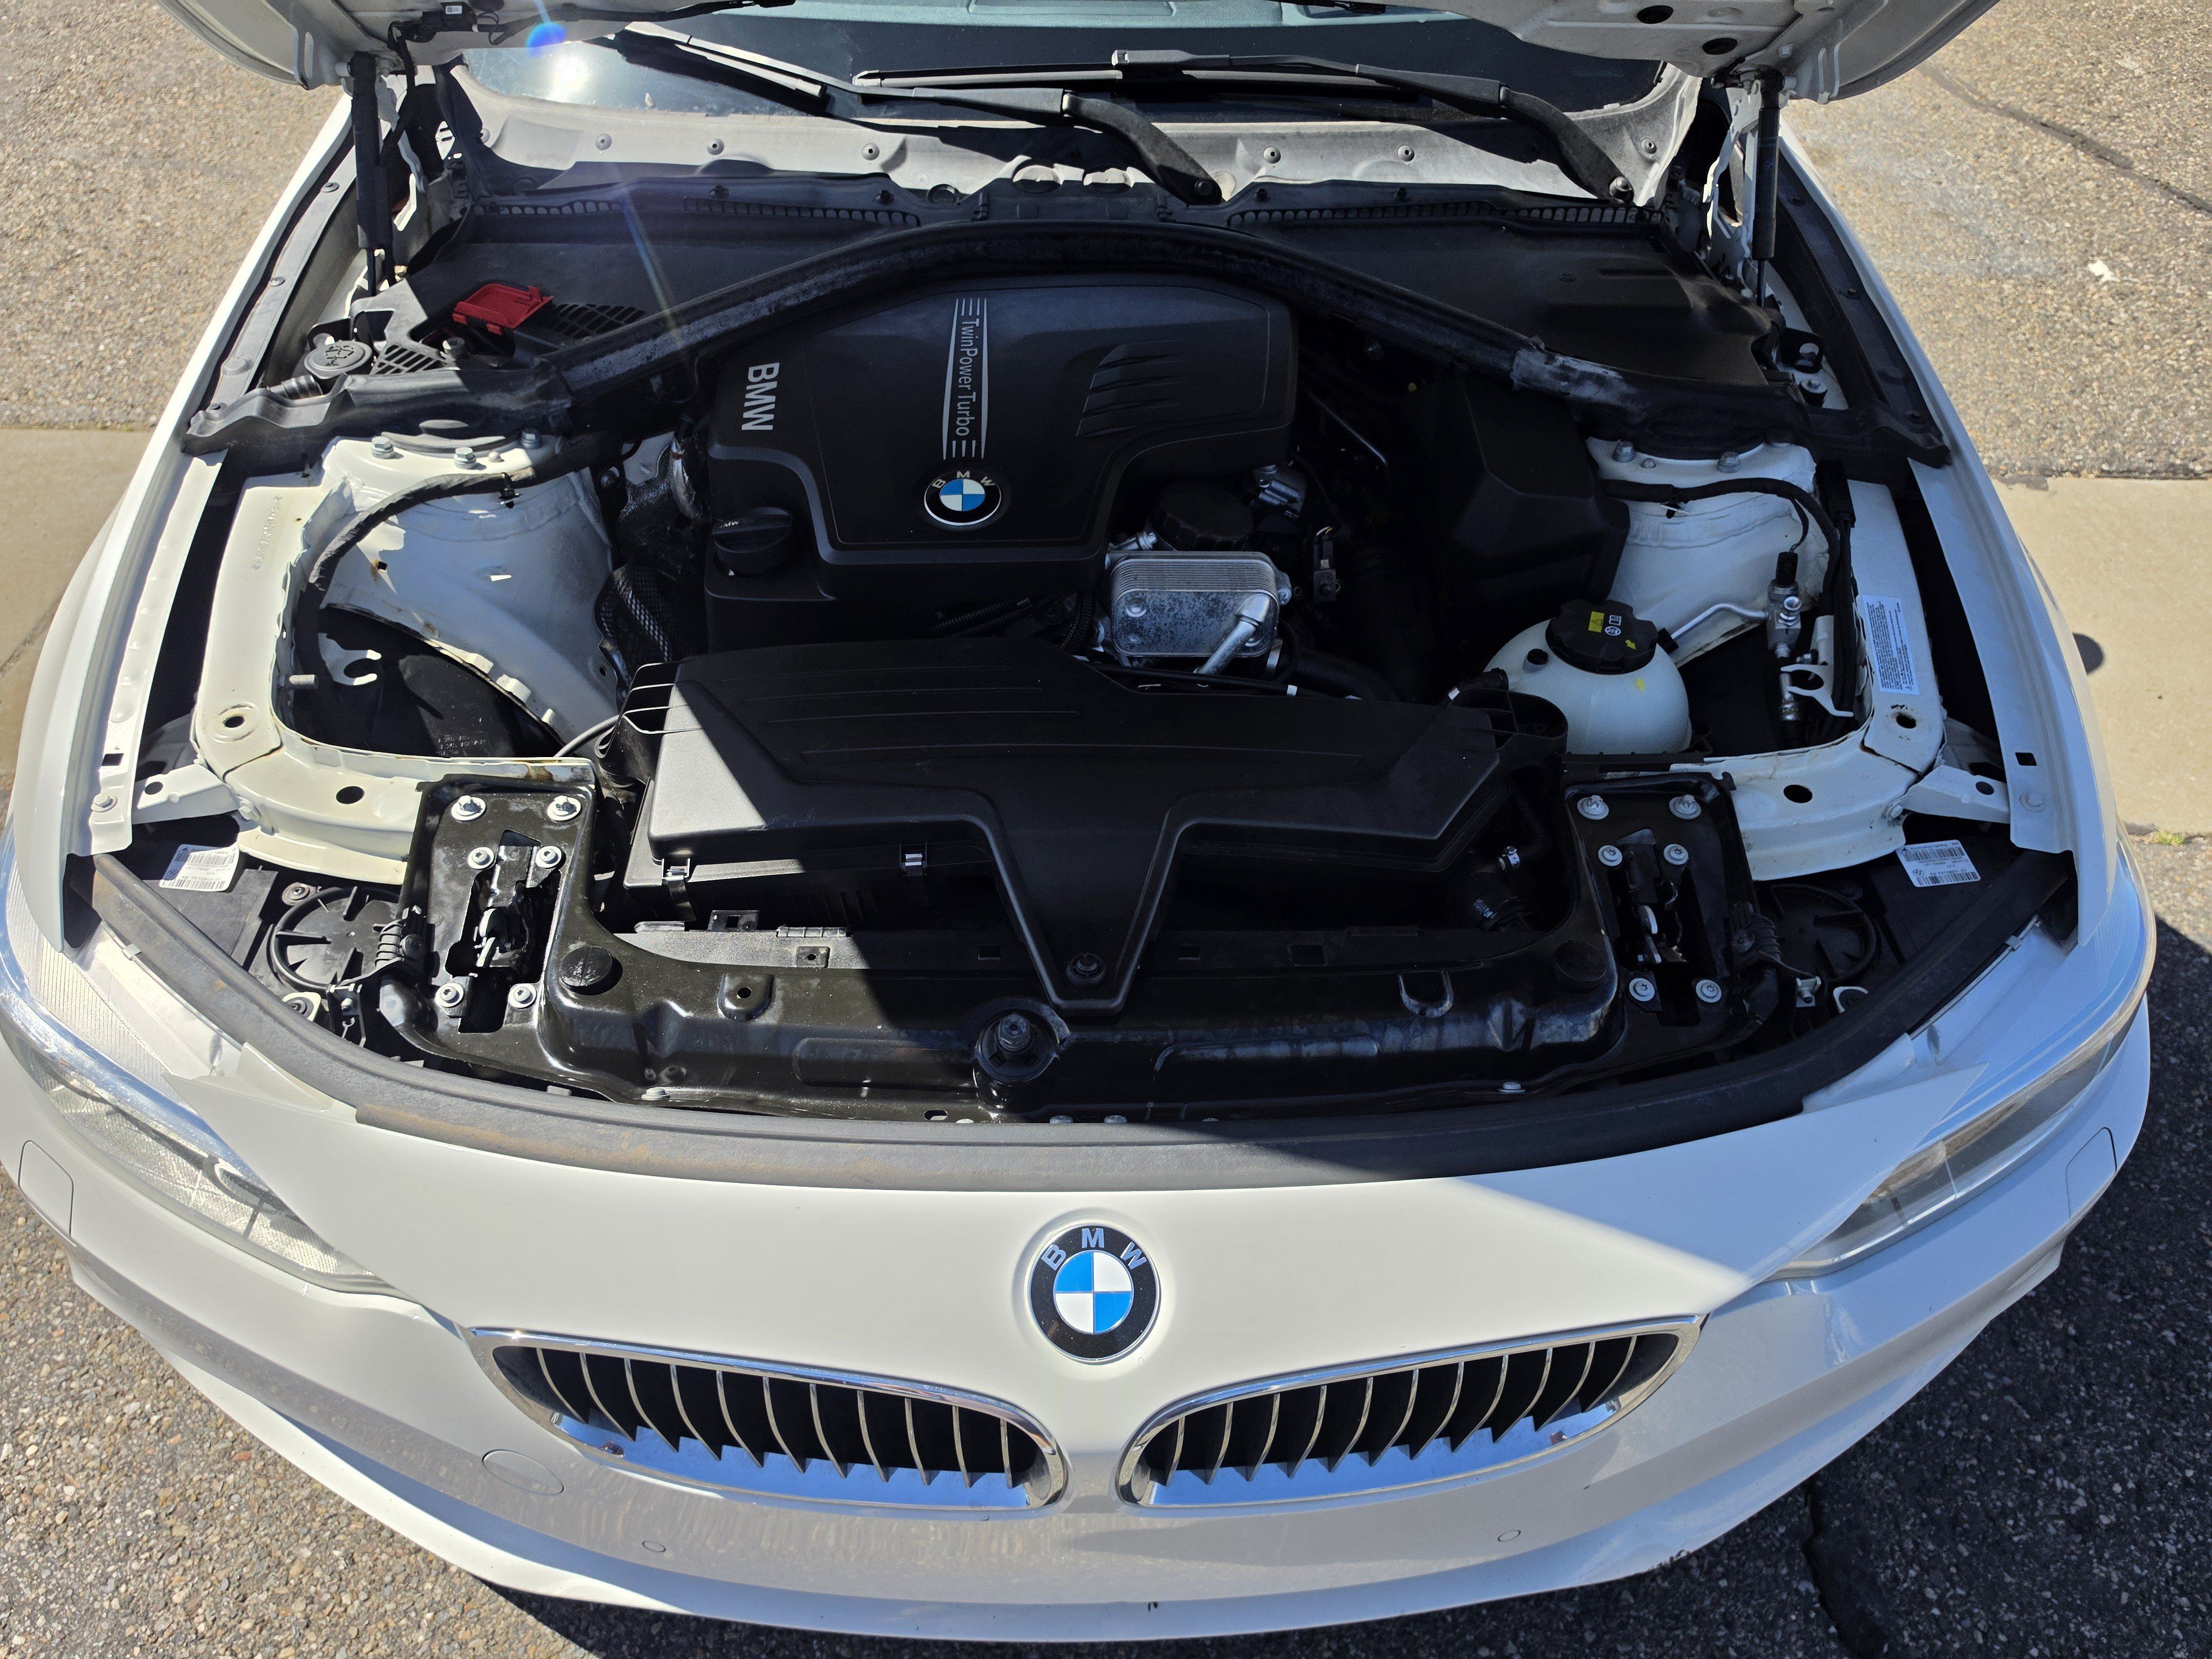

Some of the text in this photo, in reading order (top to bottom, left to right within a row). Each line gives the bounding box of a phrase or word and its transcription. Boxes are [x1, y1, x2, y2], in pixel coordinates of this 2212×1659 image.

[741, 362, 780, 431] BMW
[955, 318, 980, 436] TwinPower Turbo
[931, 470, 995, 489] BMW
[1041, 1227, 1147, 1271] BMW
